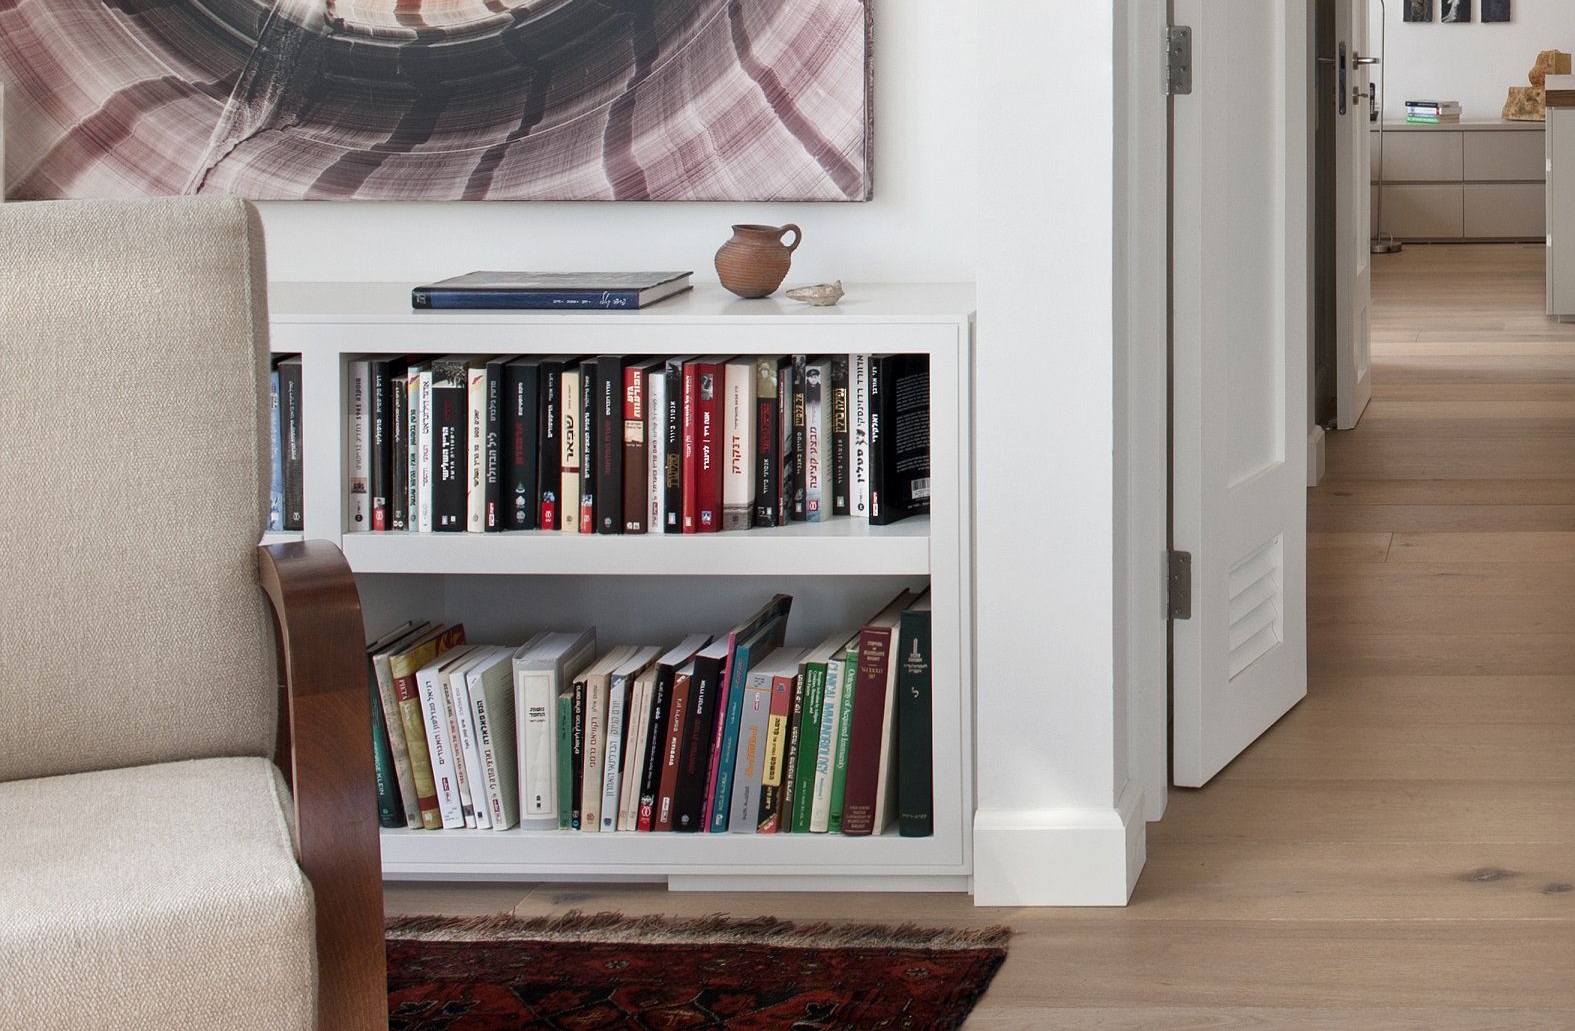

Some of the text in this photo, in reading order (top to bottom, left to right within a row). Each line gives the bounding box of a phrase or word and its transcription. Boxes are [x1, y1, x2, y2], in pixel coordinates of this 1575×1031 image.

[488, 432, 497, 447] ליל
[731, 436, 742, 474] דנקרק
[488, 449, 497, 483] הבדולח
[809, 427, 818, 489] מבצע קציצה
[856, 448, 865, 483] סטלין
[824, 662, 840, 700] CLINICAL
[844, 669, 855, 700] Ontogeny
[817, 702, 835, 775] IMMUNOBIOLOGY
[840, 707, 851, 737] Acquired
[434, 734, 445, 765] האבודים
[837, 738, 848, 770] Immunity
